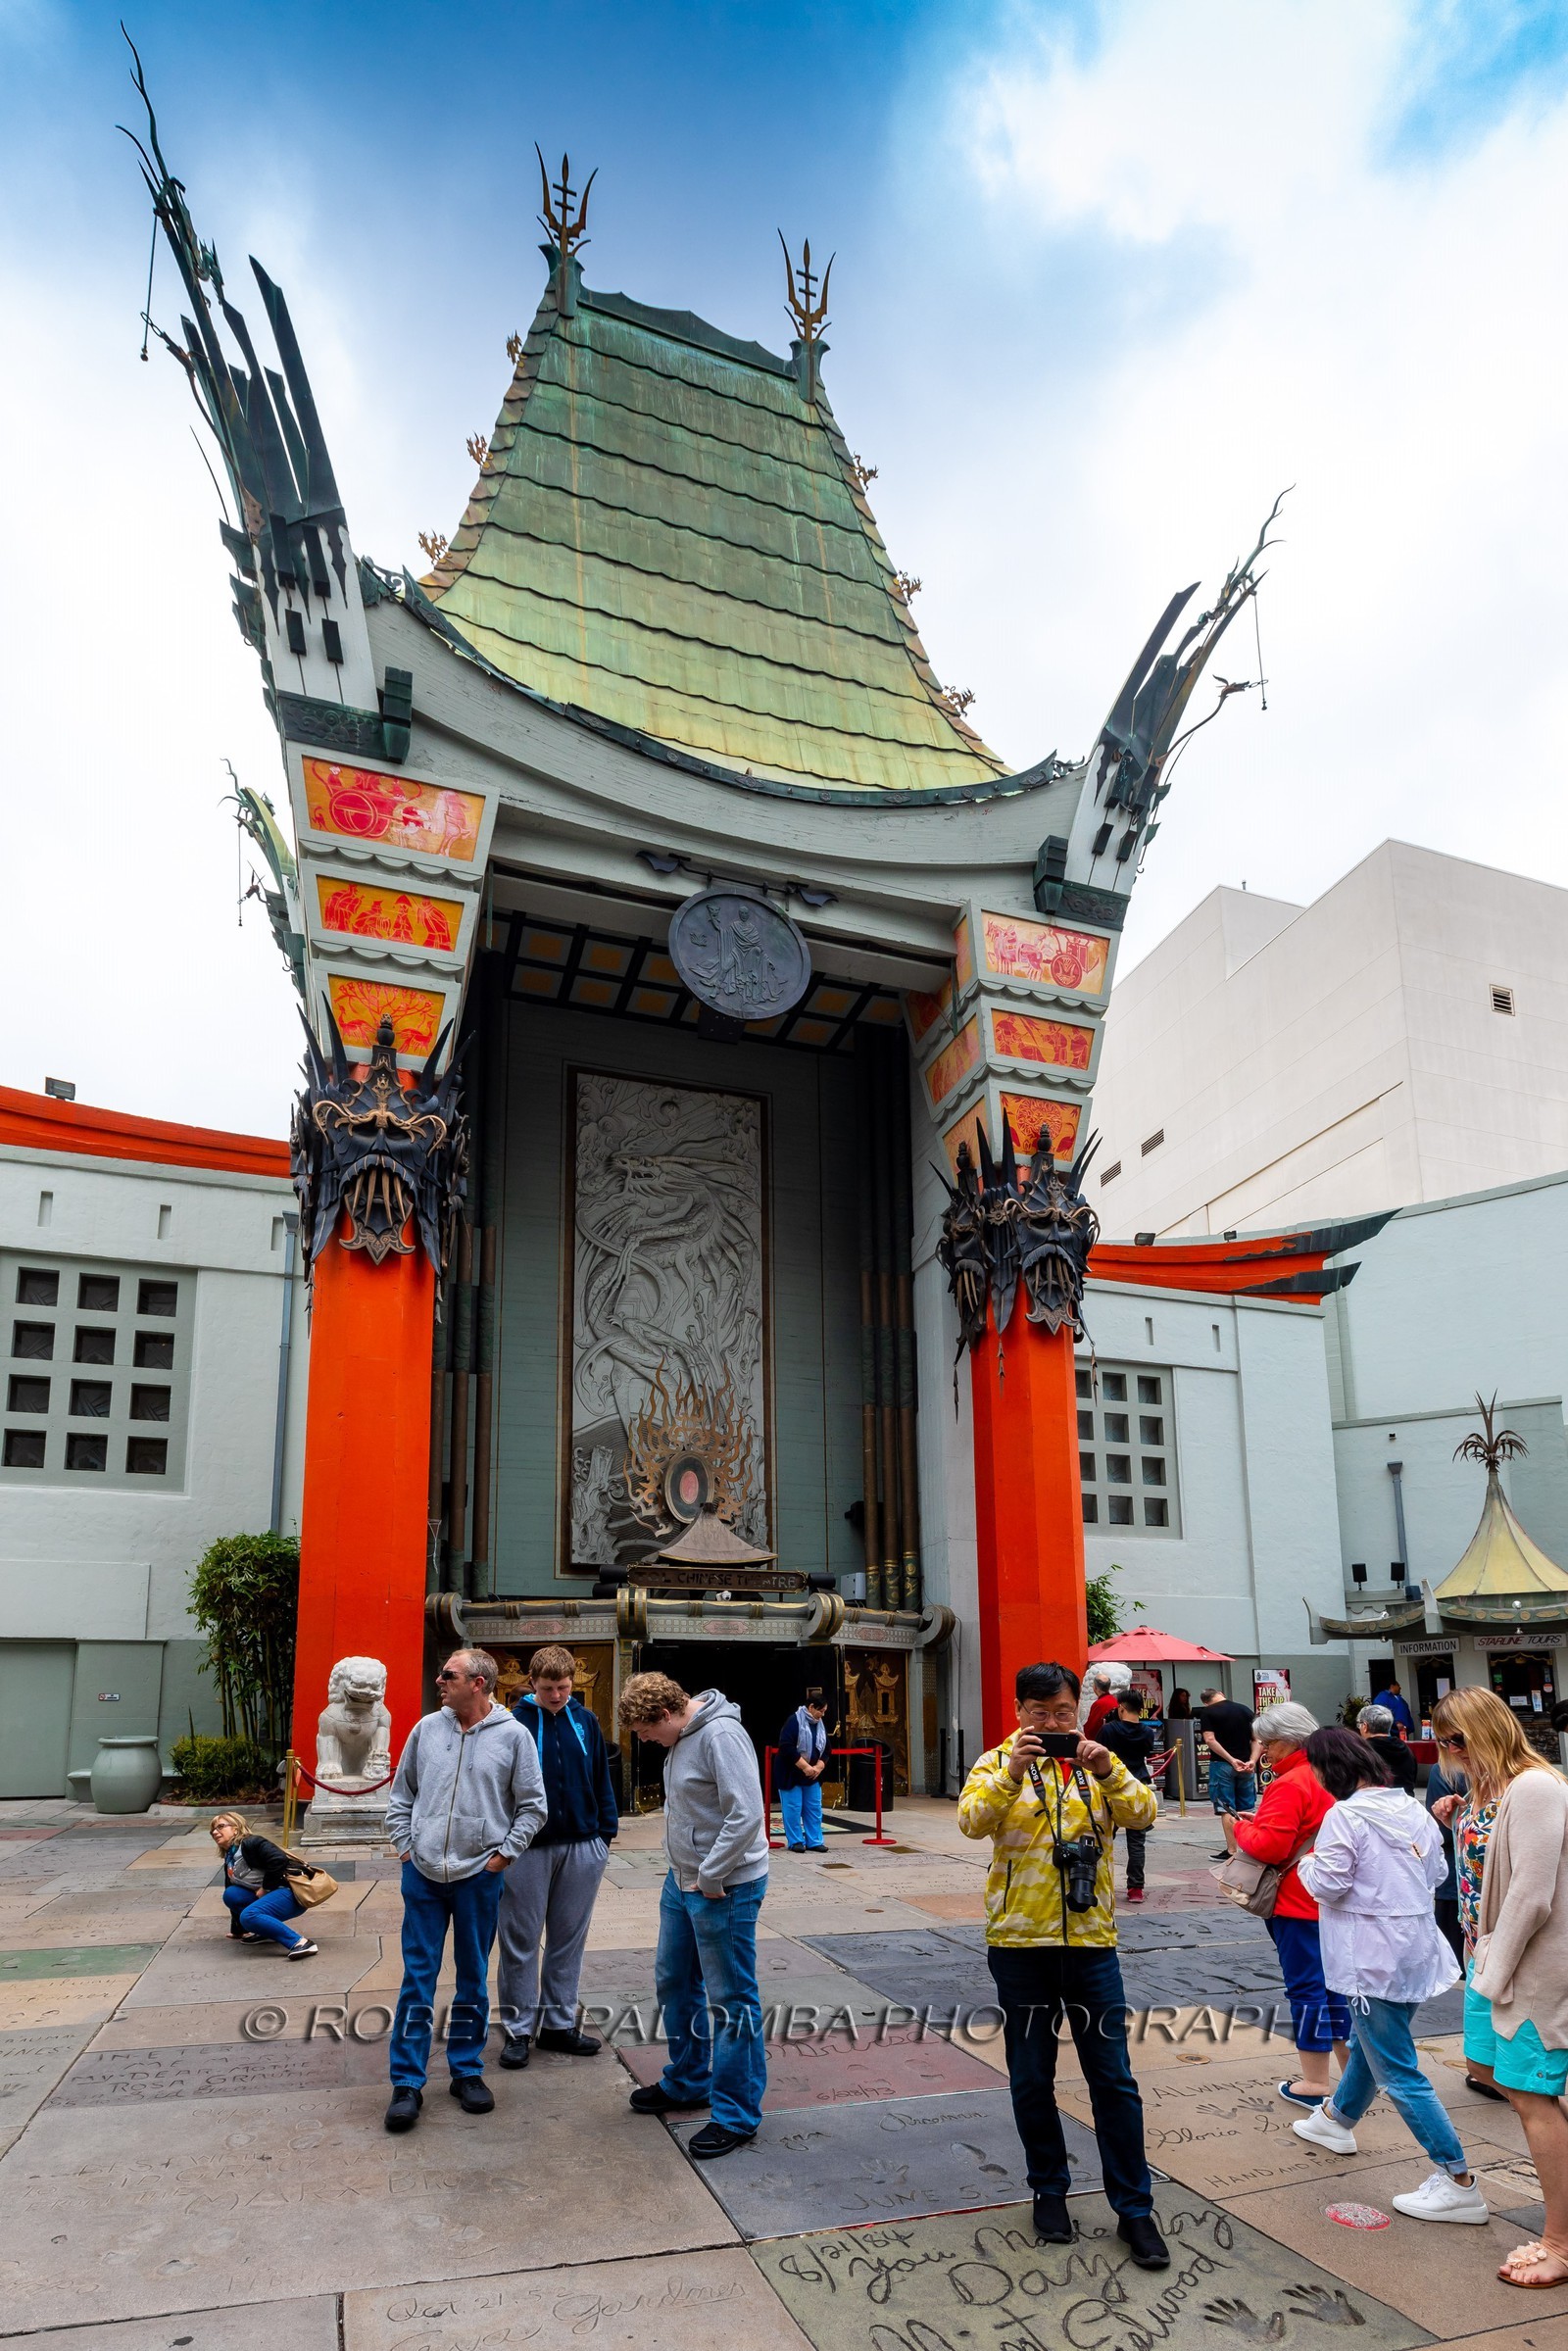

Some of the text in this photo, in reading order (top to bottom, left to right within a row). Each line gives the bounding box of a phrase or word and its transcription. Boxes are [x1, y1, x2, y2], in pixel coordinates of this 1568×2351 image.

[677, 1572, 732, 1586] CHINESE
[1399, 1640, 1457, 1654] INFORMATION
[1478, 1636, 1525, 1646] STARLINE
[1527, 1634, 1562, 1644] TOURS
[1258, 1687, 1276, 1696] TAKE
[1143, 1698, 1155, 1709] VIP
[1258, 1697, 1272, 1706] THE
[109, 2078, 186, 2093] ROSA
[816, 2083, 897, 2102] 6/28/93
[1146, 2127, 1242, 2149] Gloria
[1204, 2169, 1275, 2189] HAND
[184, 2177, 365, 2215] MARX
[839, 2188, 941, 2211] JUNE
[778, 2227, 915, 2294] 8/21/84
[849, 2249, 957, 2305] You
[944, 2253, 1131, 2306] Day
